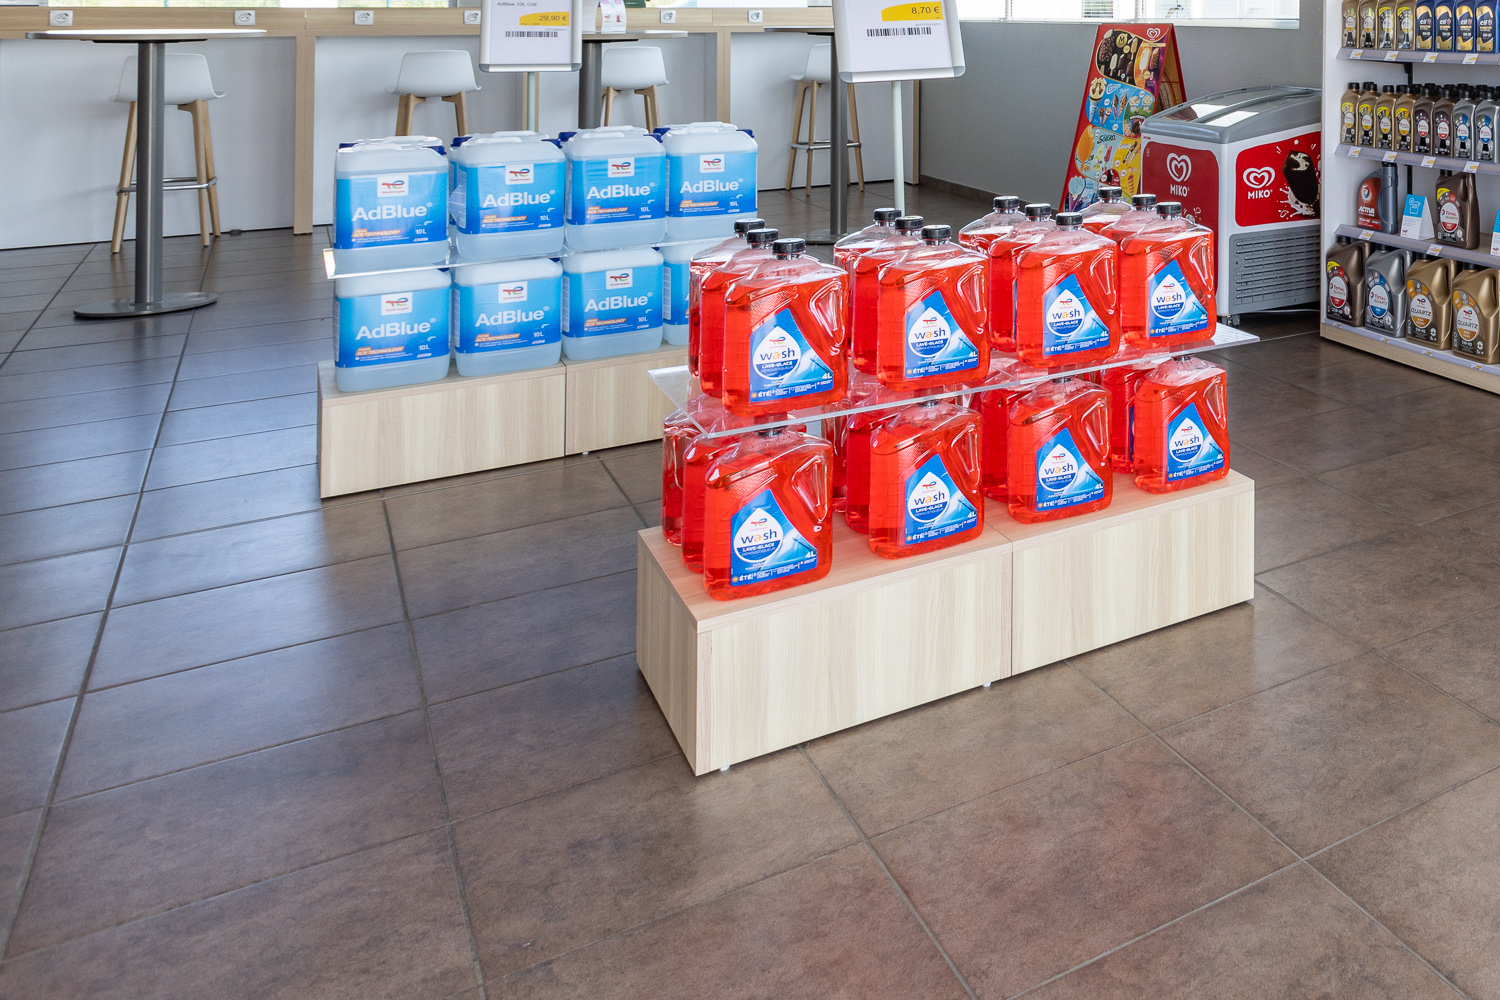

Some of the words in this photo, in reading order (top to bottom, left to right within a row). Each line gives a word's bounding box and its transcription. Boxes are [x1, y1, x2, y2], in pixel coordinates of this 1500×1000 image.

[911, 6, 931, 15] 8,70
[587, 184, 651, 199] AdBlue
[680, 179, 739, 193] AdBlue
[1170, 184, 1188, 197] MIKO
[482, 192, 551, 208] AdBlue
[1248, 190, 1270, 199] MIKO
[352, 204, 428, 221] AdBlue
[1358, 206, 1375, 214] ACTIVA
[1157, 293, 1182, 303] wash
[584, 295, 648, 313] AdBlue
[1052, 309, 1080, 319] wash
[1411, 307, 1431, 317] QUARTZ
[475, 309, 545, 327] AdBlue
[1458, 319, 1478, 330] QUARTZ
[356, 322, 431, 340] AdBlue
[915, 328, 945, 339] wash
[760, 348, 795, 361] wash
[762, 361, 792, 369] LAVE-GLACE
[1175, 436, 1199, 447] wash
[1045, 463, 1073, 474] wash
[914, 492, 945, 505] wash
[741, 529, 777, 544] wash
[742, 542, 774, 552] LAVE-GLACE
